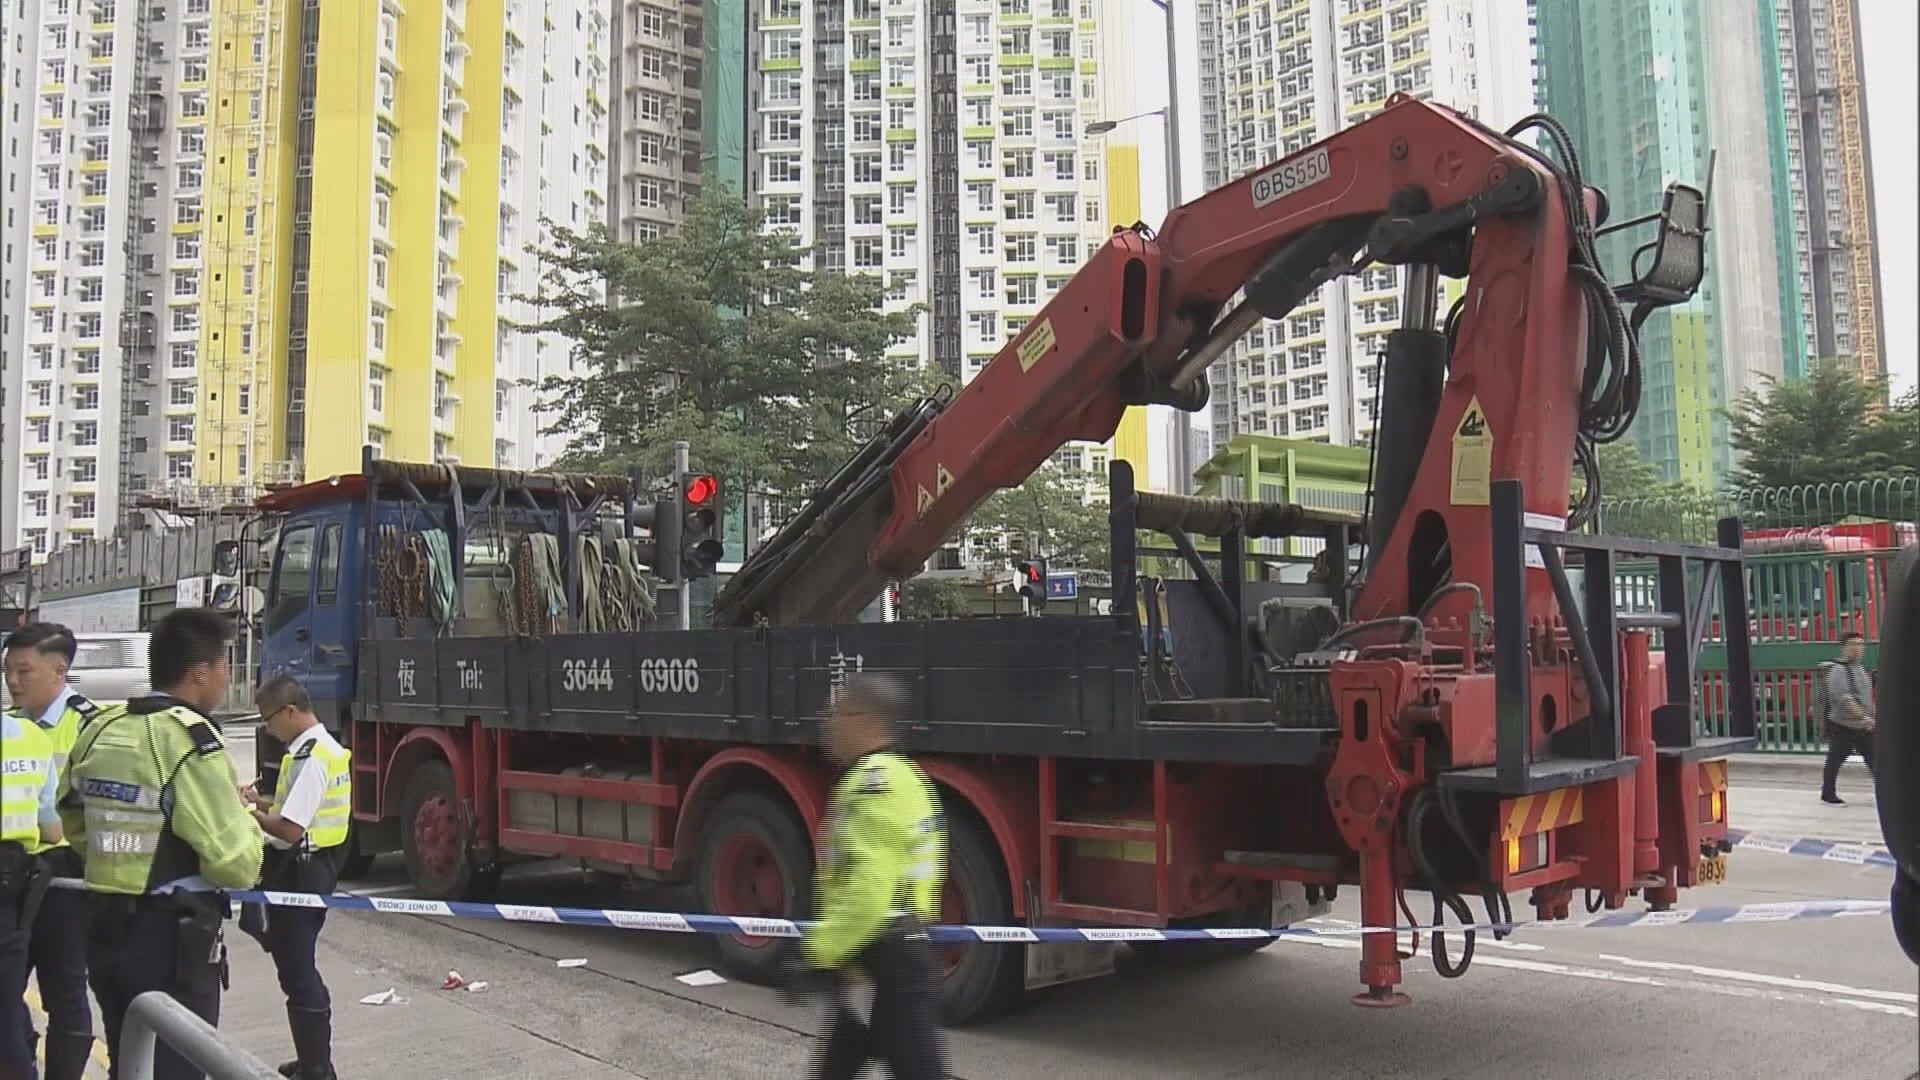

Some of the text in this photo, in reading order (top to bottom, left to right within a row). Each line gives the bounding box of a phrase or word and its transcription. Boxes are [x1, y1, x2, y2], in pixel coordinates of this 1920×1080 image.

[1271, 152, 1328, 196] BS550
[456, 658, 699, 693] Tel: 3644 6906
[377, 900, 437, 912] DO NOT CROSS
